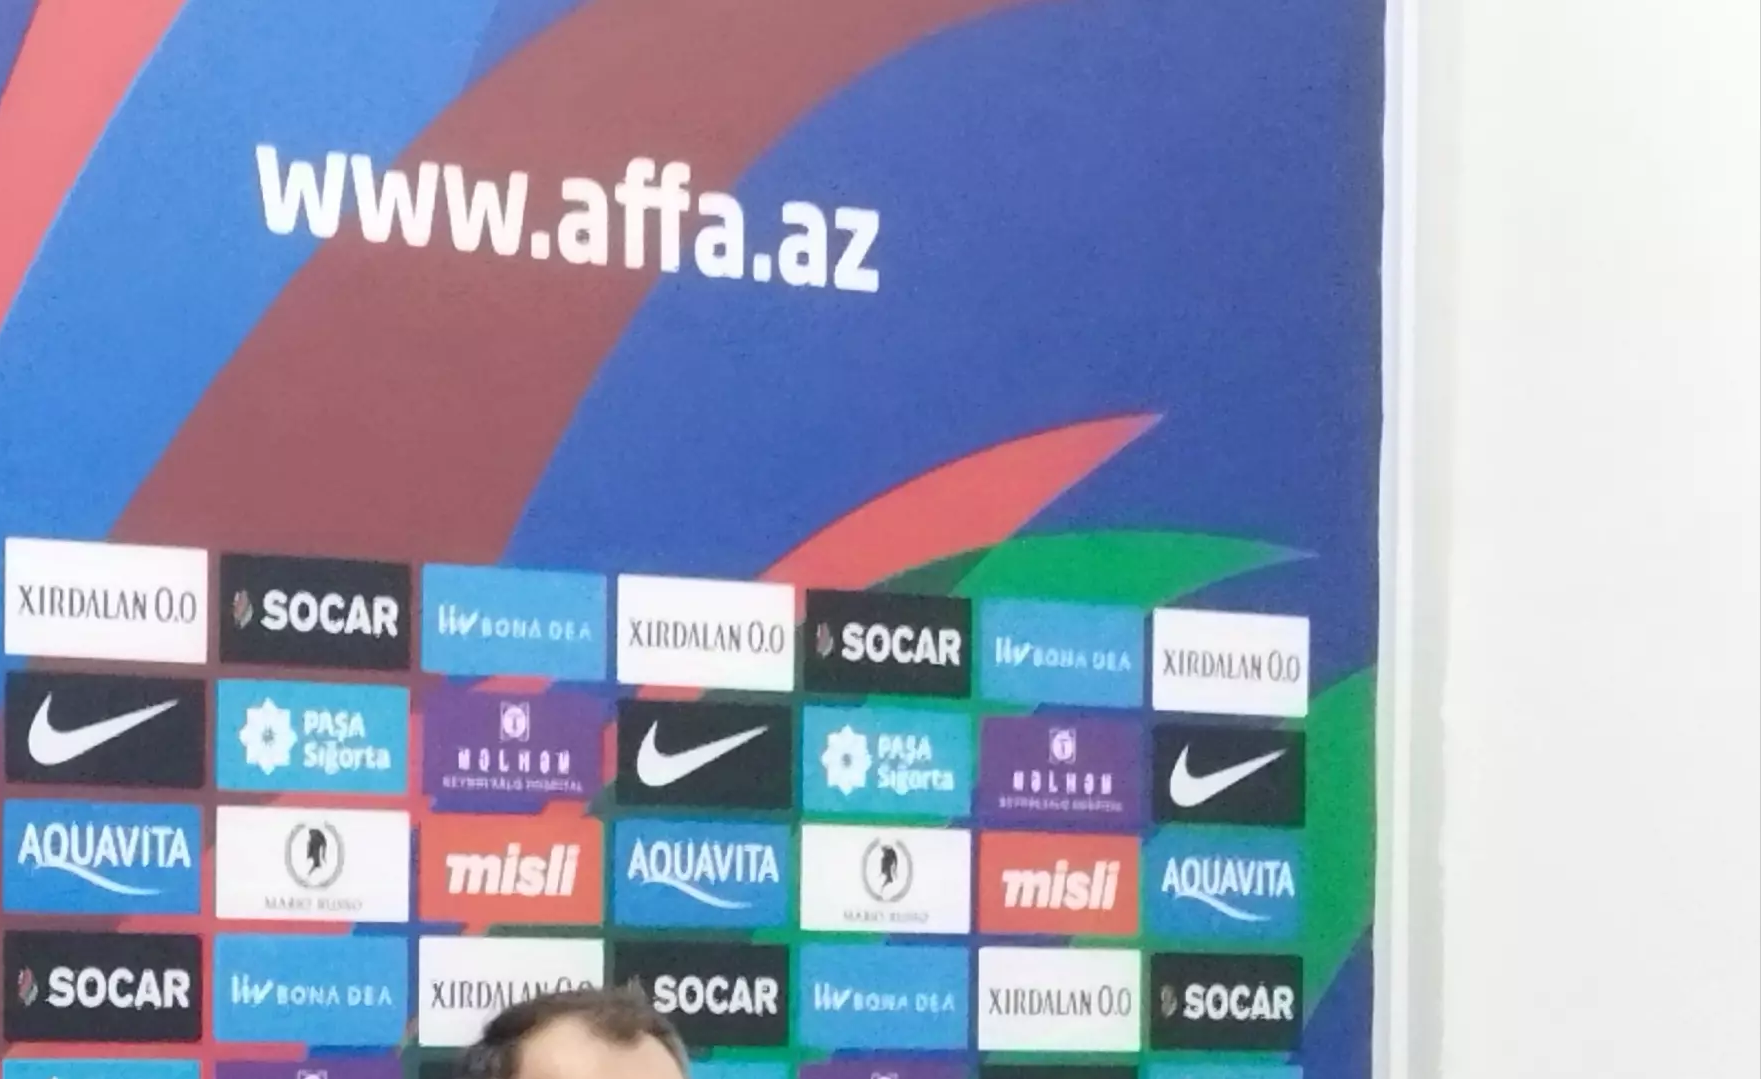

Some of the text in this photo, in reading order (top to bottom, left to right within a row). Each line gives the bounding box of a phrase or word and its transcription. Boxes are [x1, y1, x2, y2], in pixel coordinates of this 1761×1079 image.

[255, 144, 880, 292] www.affa.az
[17, 583, 196, 624] XIRDALAN 0.0
[260, 589, 397, 637] SOCAR
[627, 618, 783, 655] XIRDALAN 0.0
[839, 622, 959, 667] SOCAR
[1162, 648, 1300, 682] XIRDALAN 0.0
[19, 820, 192, 868] AQUAVITA
[627, 839, 778, 884] AQUAVITA
[445, 841, 579, 898] misli
[1001, 858, 1119, 911] misli
[1162, 856, 1296, 897] AQUAVITA
[48, 965, 191, 1008] SOCAR
[652, 975, 777, 1015] SOCAR
[988, 985, 1131, 1017] XIRDALAN 0.0
[1183, 983, 1294, 1020] SOCAR
